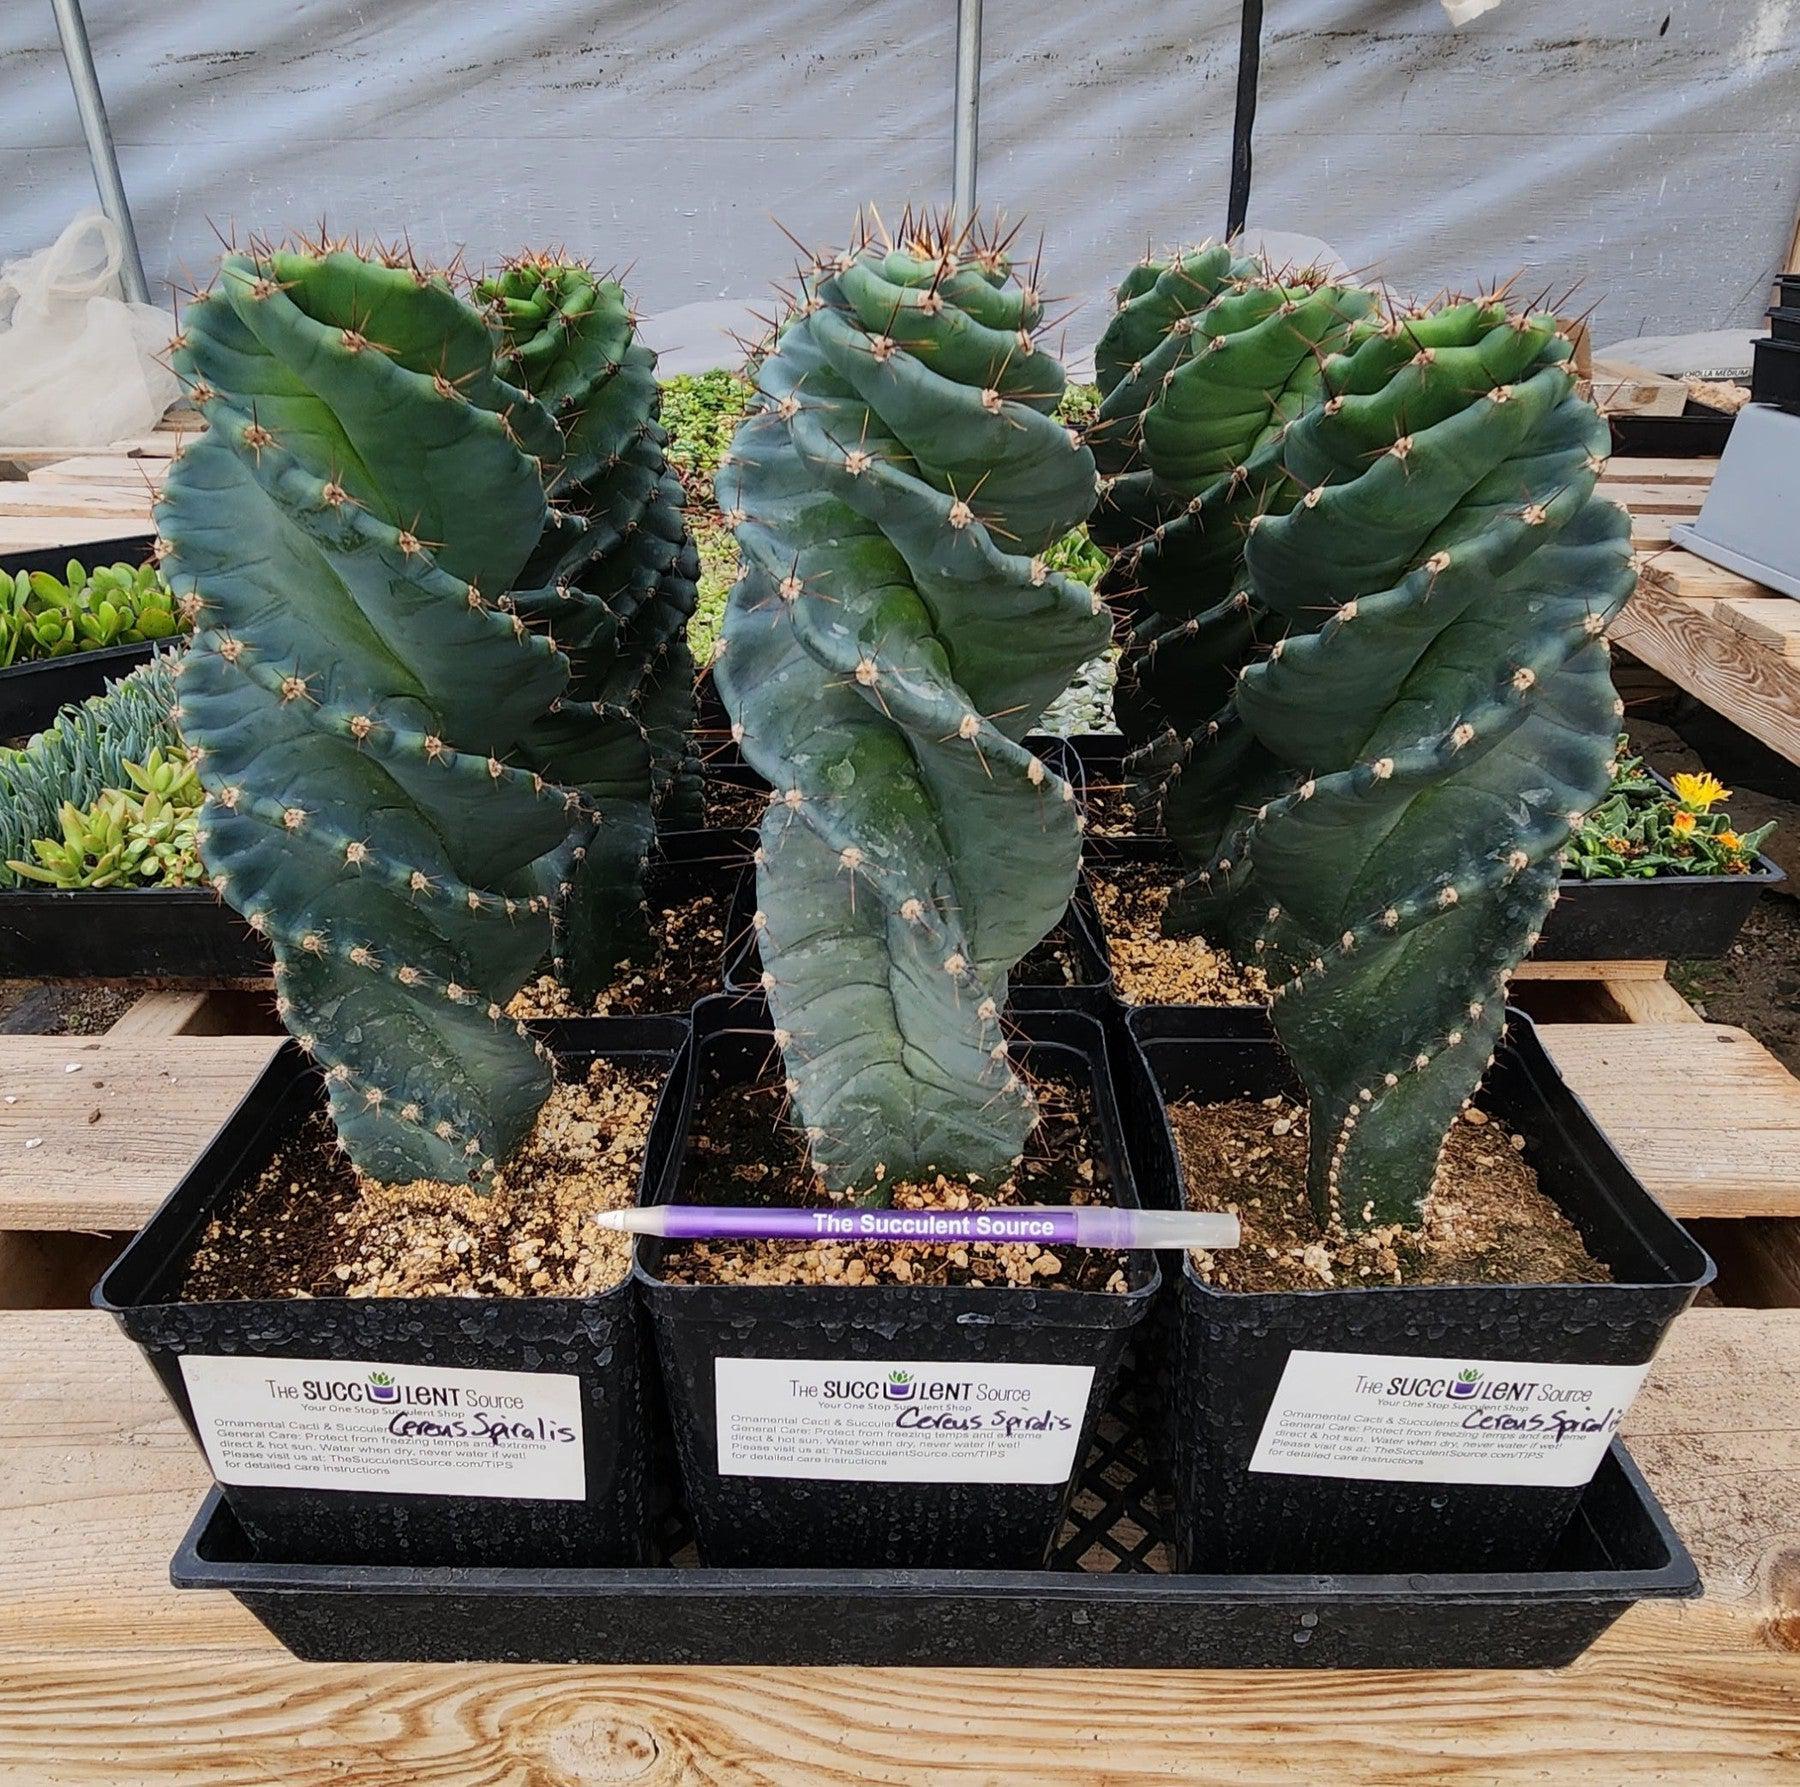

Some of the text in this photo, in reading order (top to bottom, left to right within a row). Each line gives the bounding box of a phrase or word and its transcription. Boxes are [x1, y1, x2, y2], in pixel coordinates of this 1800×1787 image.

[812, 1213, 1055, 1236] The Succulent Source
[466, 1389, 524, 1409] Source
[976, 1383, 1031, 1401] Source
[1537, 1384, 1593, 1403] Source
[300, 1403, 326, 1413] Your
[329, 1405, 351, 1413] One
[354, 1406, 379, 1415] Stop
[437, 1409, 465, 1418] Shop
[818, 1401, 841, 1409] Your
[843, 1402, 865, 1410] One
[867, 1403, 891, 1411] Stop
[945, 1404, 972, 1412] Shop
[1377, 1398, 1401, 1407] Your
[1402, 1400, 1424, 1408] One
[1426, 1402, 1449, 1410] Stop
[1503, 1404, 1529, 1413] Shop
[214, 1418, 285, 1429] Ornamental
[288, 1421, 320, 1430] Cacti
[323, 1422, 332, 1430] &
[730, 1414, 798, 1424] Ornamental
[801, 1417, 831, 1426] Cacti
[834, 1418, 842, 1426] &
[895, 1406, 1072, 1436] Cereus Spiralis
[1282, 1409, 1459, 1428] Ornamental Cacti & Succulents
[471, 1412, 576, 1445] Spiralis
[731, 1424, 777, 1433] General
[815, 1427, 855, 1436] Protect
[858, 1428, 884, 1437] from
[887, 1429, 931, 1440] freezing
[935, 1431, 970, 1440] temps
[972, 1431, 994, 1439] and
[1279, 1419, 1326, 1430] General
[1362, 1425, 1404, 1435] Protect
[1406, 1427, 1432, 1437] from
[1434, 1429, 1479, 1440] freezing
[1482, 1431, 1516, 1440] temps
[1518, 1432, 1540, 1440] and
[1542, 1433, 1587, 1441] exeme
[216, 1429, 265, 1439] General
[268, 1431, 300, 1440] Care:
[305, 1433, 348, 1442] Protect
[351, 1434, 379, 1444] from
[382, 1435, 430, 1447] freezing
[433, 1439, 470, 1448] temps
[730, 1434, 763, 1442] direct
[777, 1435, 796, 1444] hot
[825, 1437, 859, 1446] Water
[862, 1439, 893, 1447] when
[987, 1441, 996, 1449] if
[1272, 1438, 1311, 1449] Please
[1314, 1442, 1337, 1451] visit
[1355, 1445, 1371, 1453] at:
[1275, 1429, 1307, 1439] direct
[1310, 1431, 1319, 1439] &
[1322, 1432, 1341, 1441] hot
[1370, 1435, 1404, 1445] Water
[1407, 1438, 1437, 1448] when
[1463, 1441, 1495, 1449] never
[1497, 1442, 1528, 1450] water
[1530, 1442, 1538, 1450] if
[220, 1440, 253, 1448] direct
[256, 1441, 265, 1449] &
[268, 1441, 288, 1450] hot
[319, 1443, 355, 1453] Water
[358, 1445, 390, 1455] when
[421, 1449, 451, 1457] never
[456, 1450, 489, 1458] water
[492, 1451, 499, 1459] if
[222, 1450, 264, 1459] Please
[266, 1452, 290, 1460] visit
[311, 1454, 326, 1462] at:
[731, 1443, 770, 1451] Please
[773, 1445, 795, 1453] visit
[750, 1453, 794, 1462] detailed
[824, 1456, 887, 1466] instructions
[1267, 1448, 1425, 1466] for detailed care instructions
[225, 1460, 240, 1468] for
[244, 1461, 291, 1470] detailed
[323, 1465, 390, 1475] instructions
